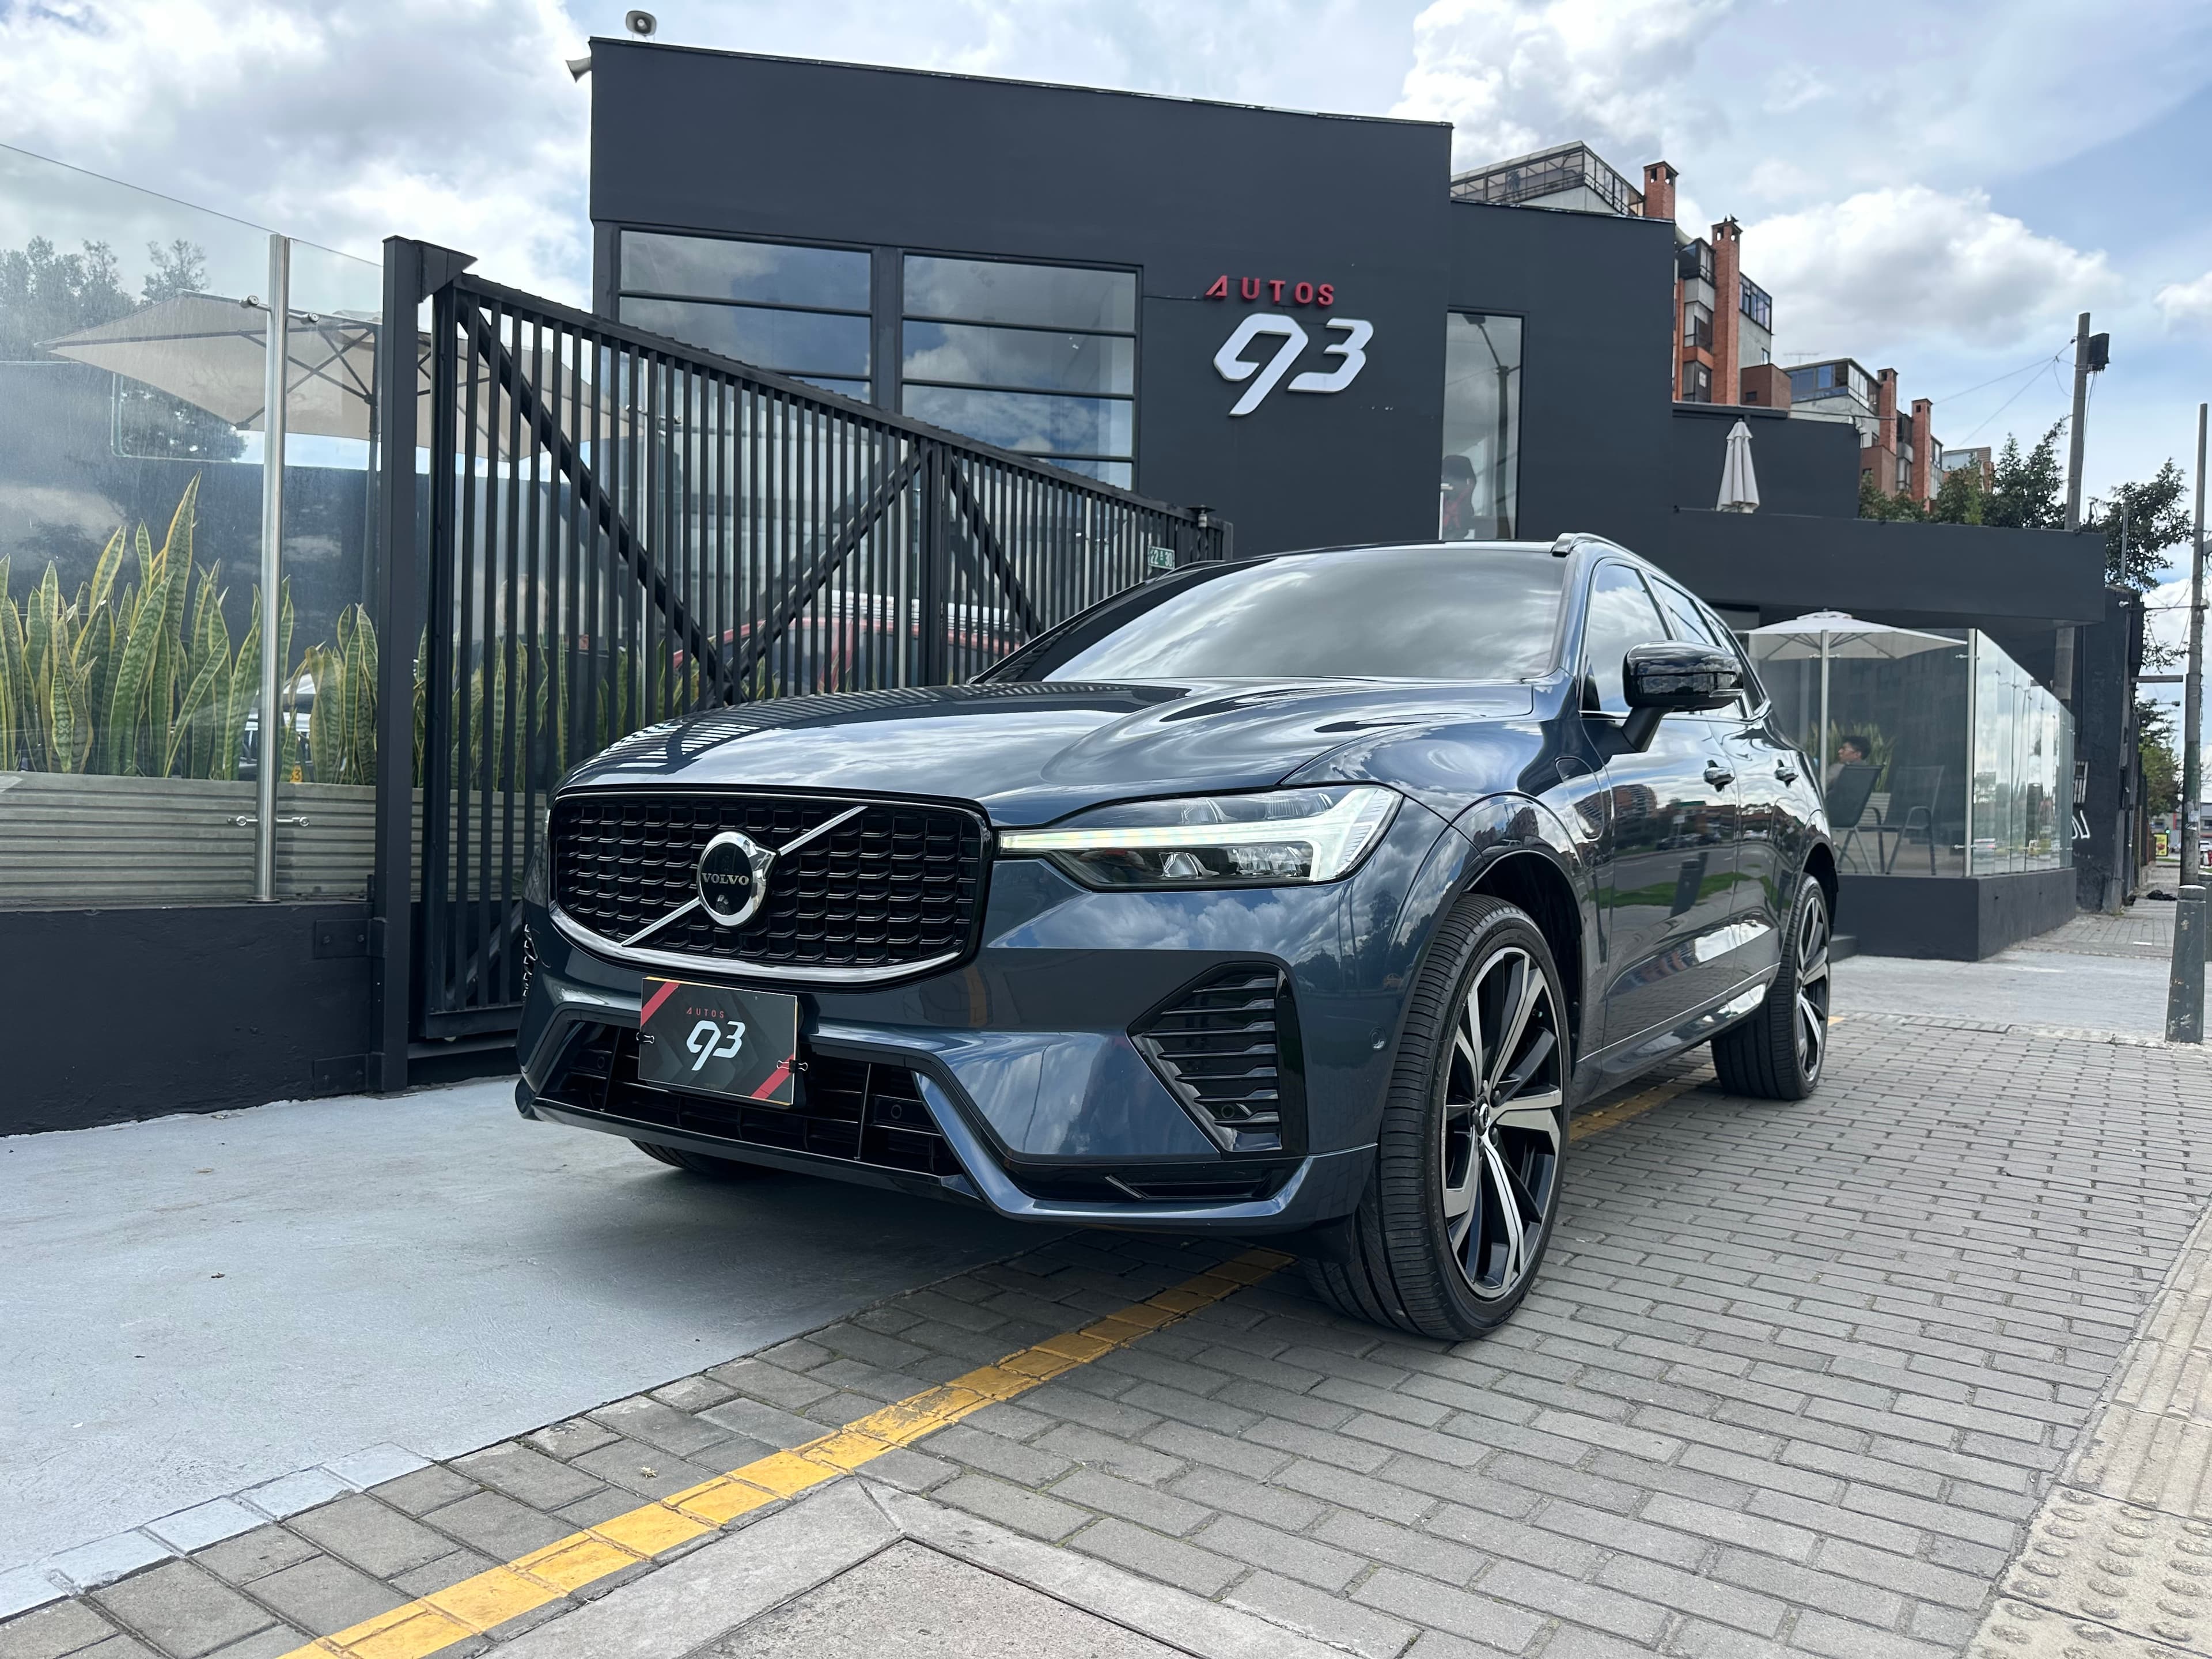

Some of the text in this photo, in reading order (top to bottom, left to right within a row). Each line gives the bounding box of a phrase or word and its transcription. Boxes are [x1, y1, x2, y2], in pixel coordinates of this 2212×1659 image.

[1205, 275, 1334, 306] AUTOS
[1213, 312, 1374, 416] 93
[702, 873, 749, 885] VOLVO
[686, 1007, 724, 1018] AUTOS
[686, 1020, 745, 1071] 93
